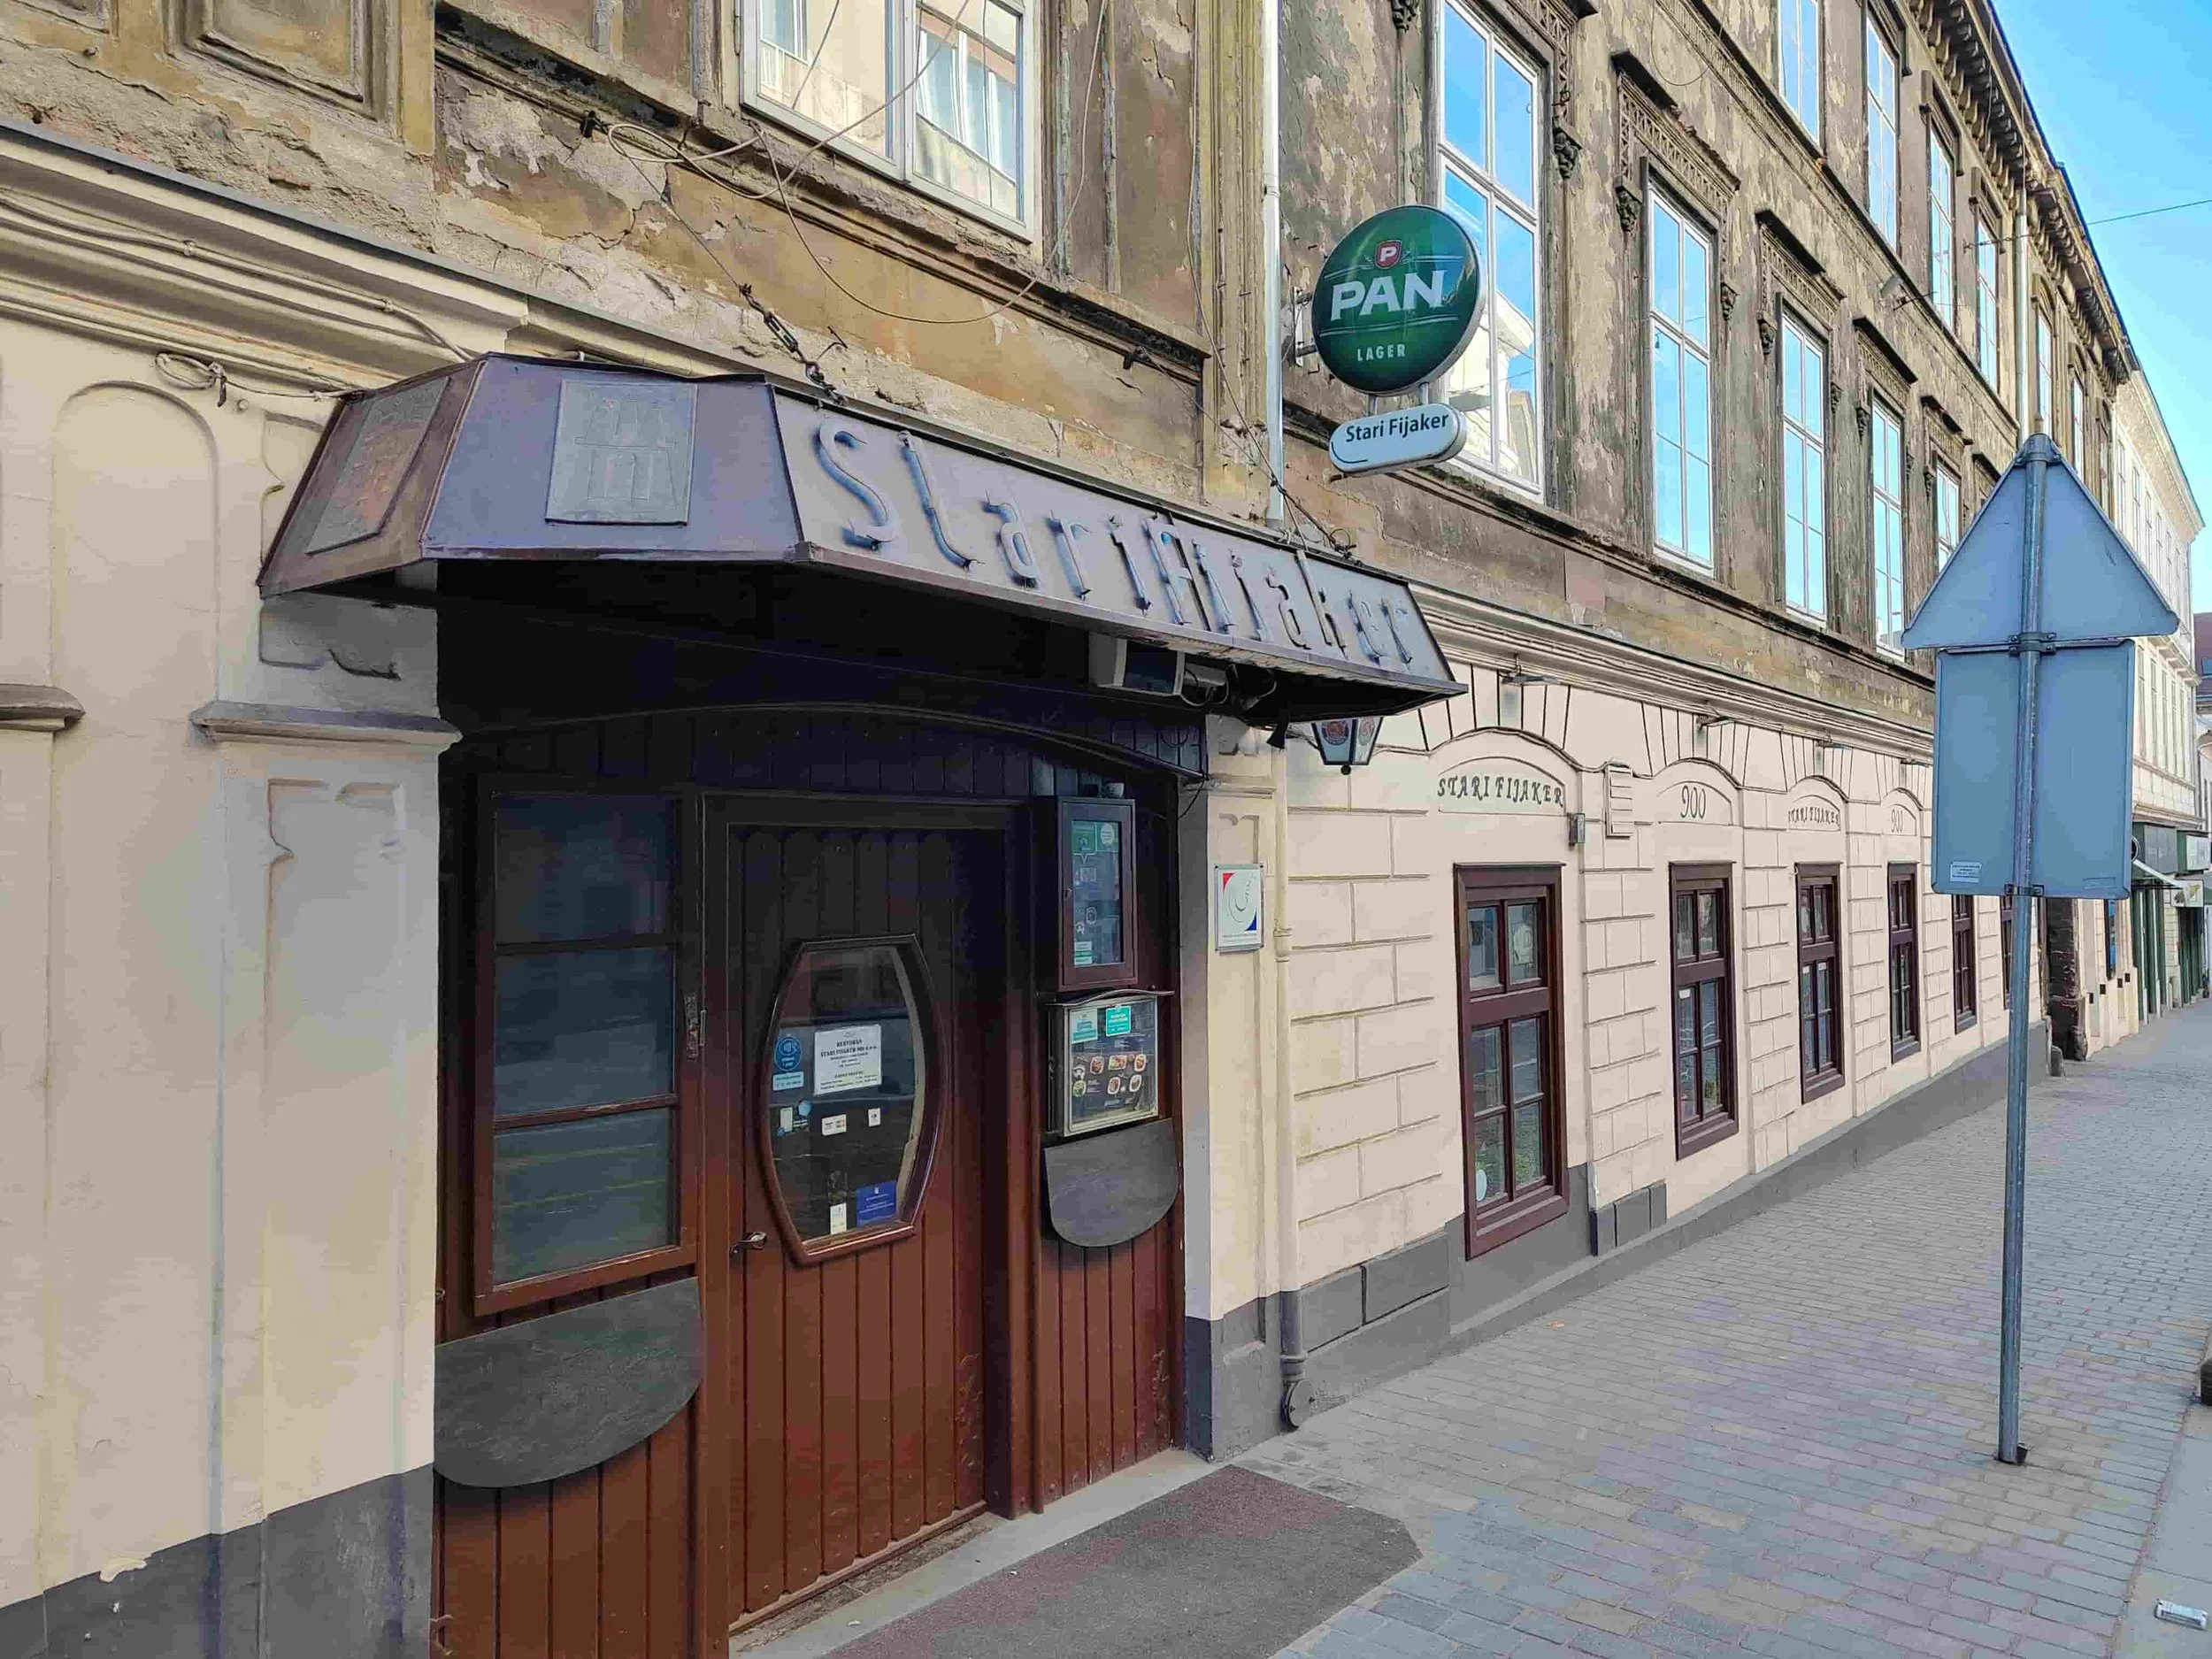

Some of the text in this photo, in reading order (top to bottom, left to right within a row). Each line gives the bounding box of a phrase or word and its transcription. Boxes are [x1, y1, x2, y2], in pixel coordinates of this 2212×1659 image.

[1379, 246, 1398, 263] P
[1331, 270, 1447, 321] PAN
[1356, 342, 1406, 362] LAGER
[1345, 411, 1448, 443] Stari Fijaker
[810, 422, 1152, 614] Stari
[1437, 775, 1564, 808] STARI FIJAKER
[1679, 785, 1707, 819] 900
